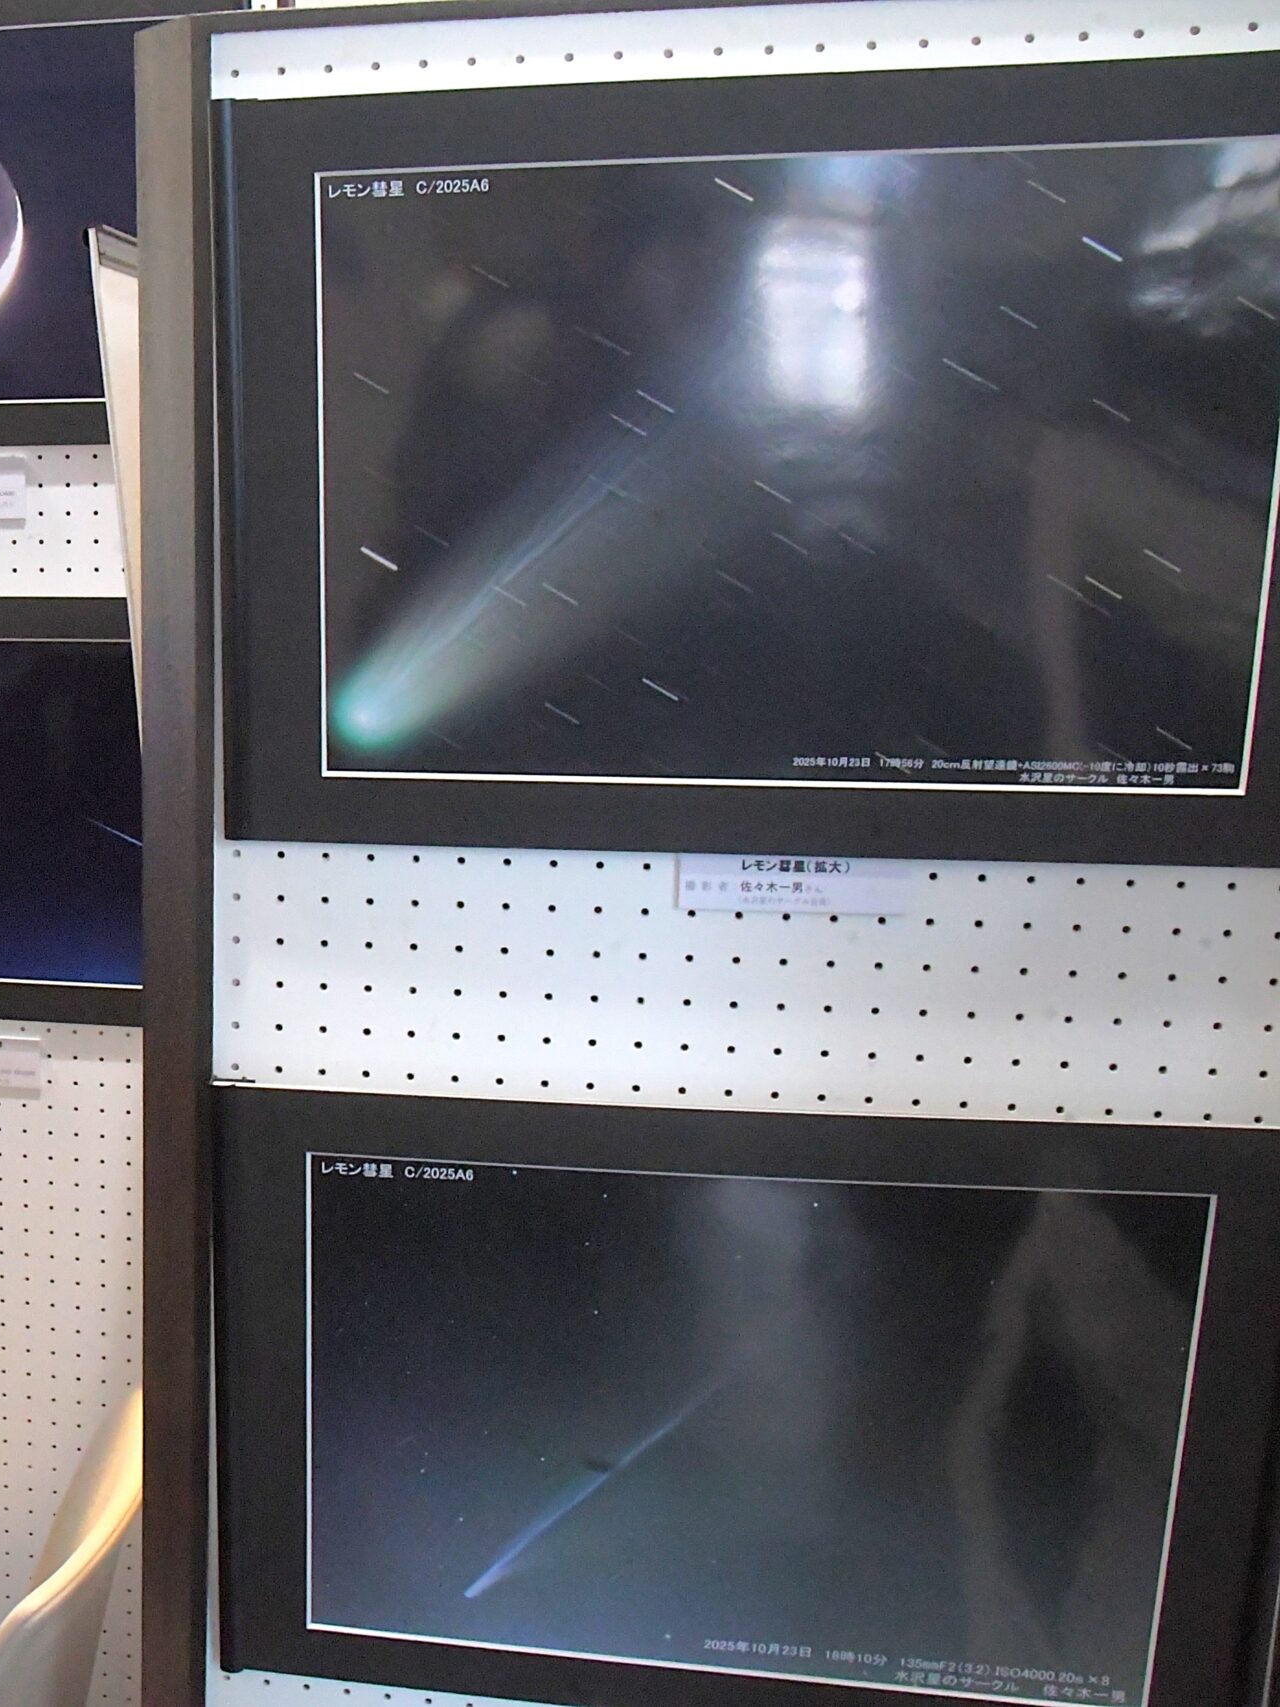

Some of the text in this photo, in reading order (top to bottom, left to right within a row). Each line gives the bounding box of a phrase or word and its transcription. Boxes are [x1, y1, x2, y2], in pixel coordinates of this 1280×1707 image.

[328, 178, 490, 199] レモン彗星 C/2025A6
[792, 756, 871, 768] 2025年10月23日
[1116, 774, 1175, 786] 佐々木一男
[321, 1161, 474, 1181] レモン彗星 C/2025A6
[704, 1638, 812, 1659] 2025年10月23日
[1043, 1684, 1126, 1703] 佐々木一男
